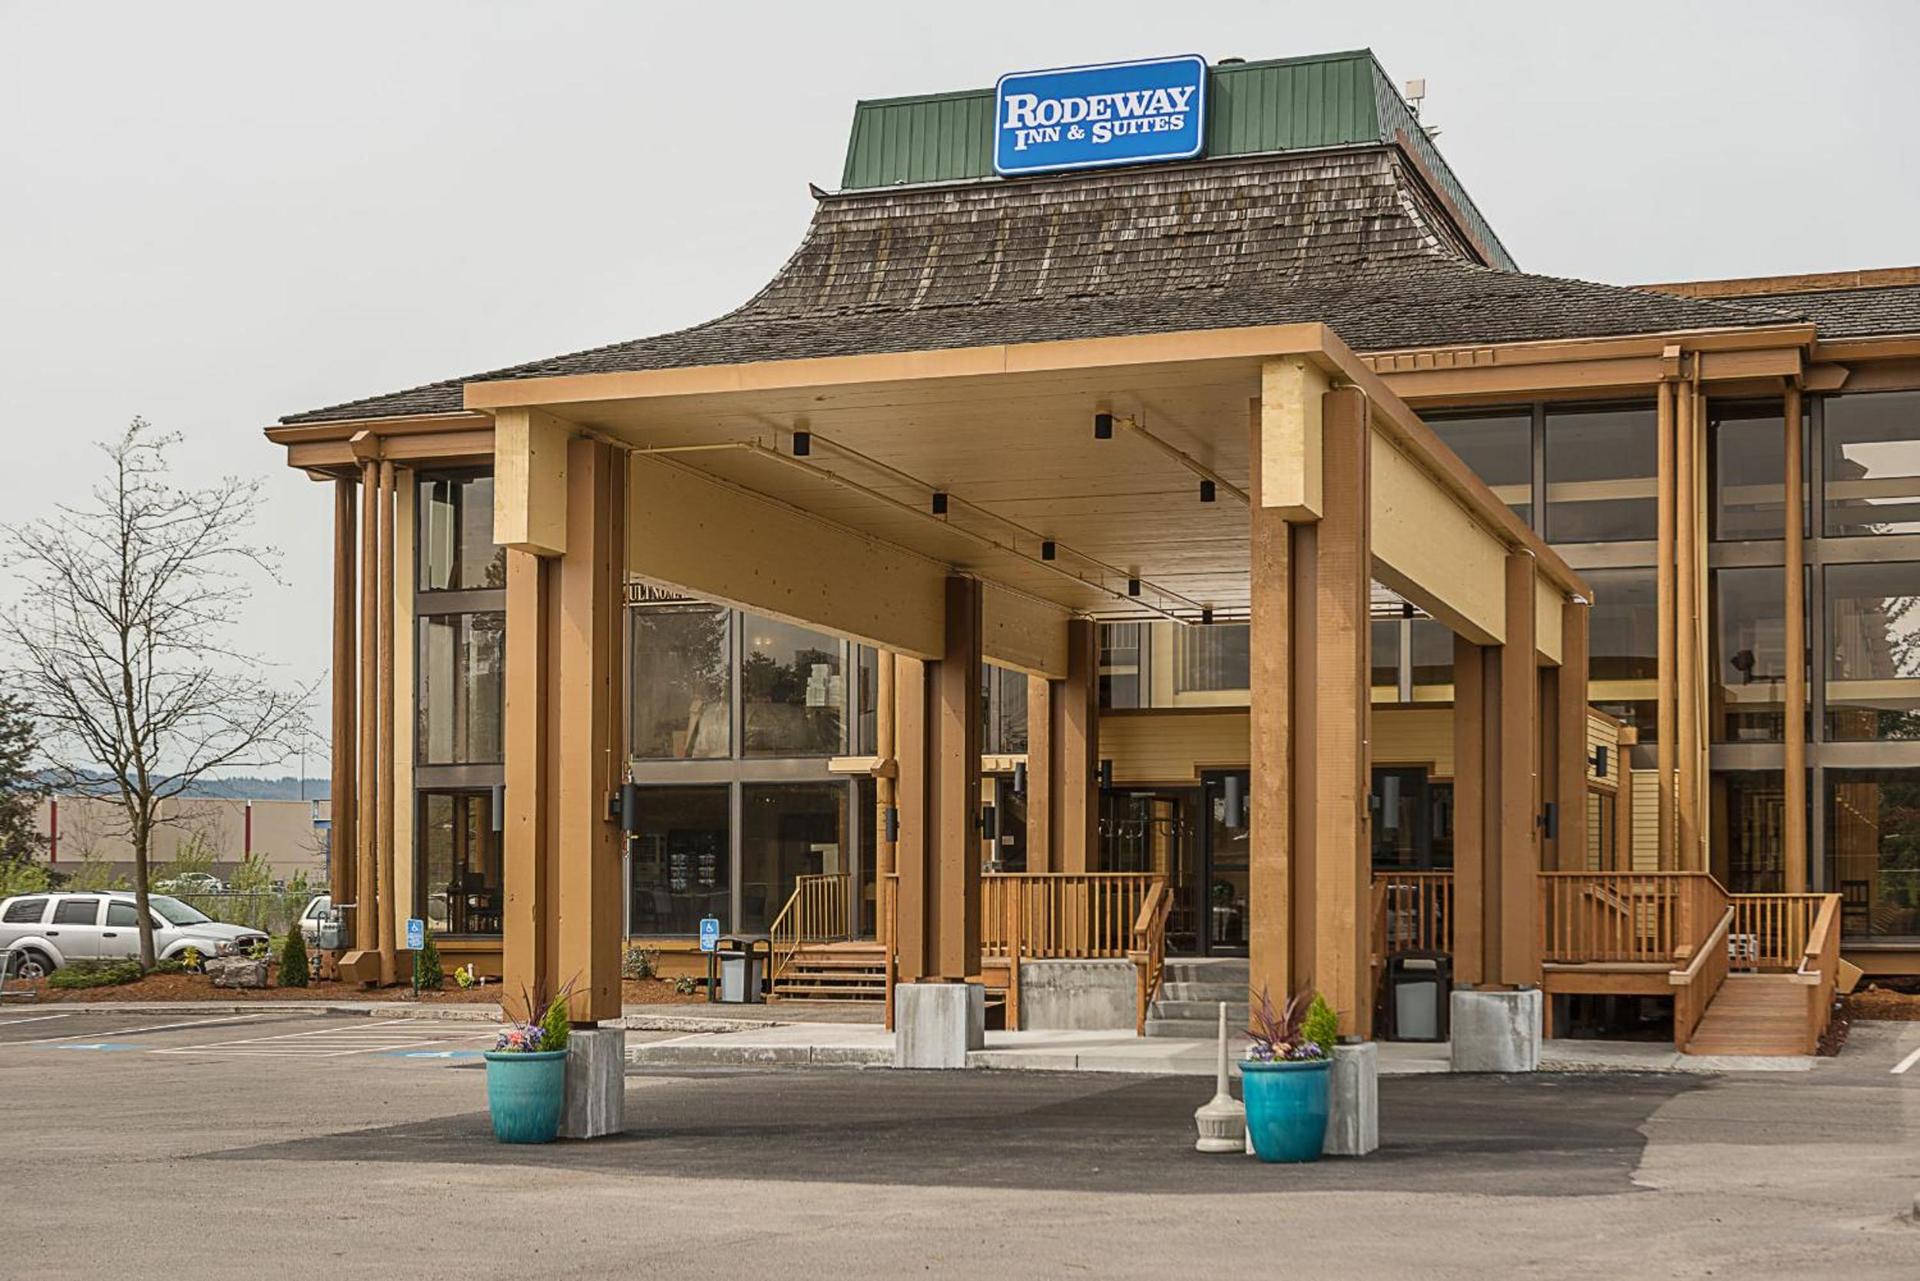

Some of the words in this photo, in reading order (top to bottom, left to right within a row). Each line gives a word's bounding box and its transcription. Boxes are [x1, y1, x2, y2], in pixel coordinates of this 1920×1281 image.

[1003, 86, 1195, 129] RODEWAY
[1014, 127, 1061, 151] INN
[1067, 124, 1085, 140] &
[1092, 114, 1185, 144] SUITES
